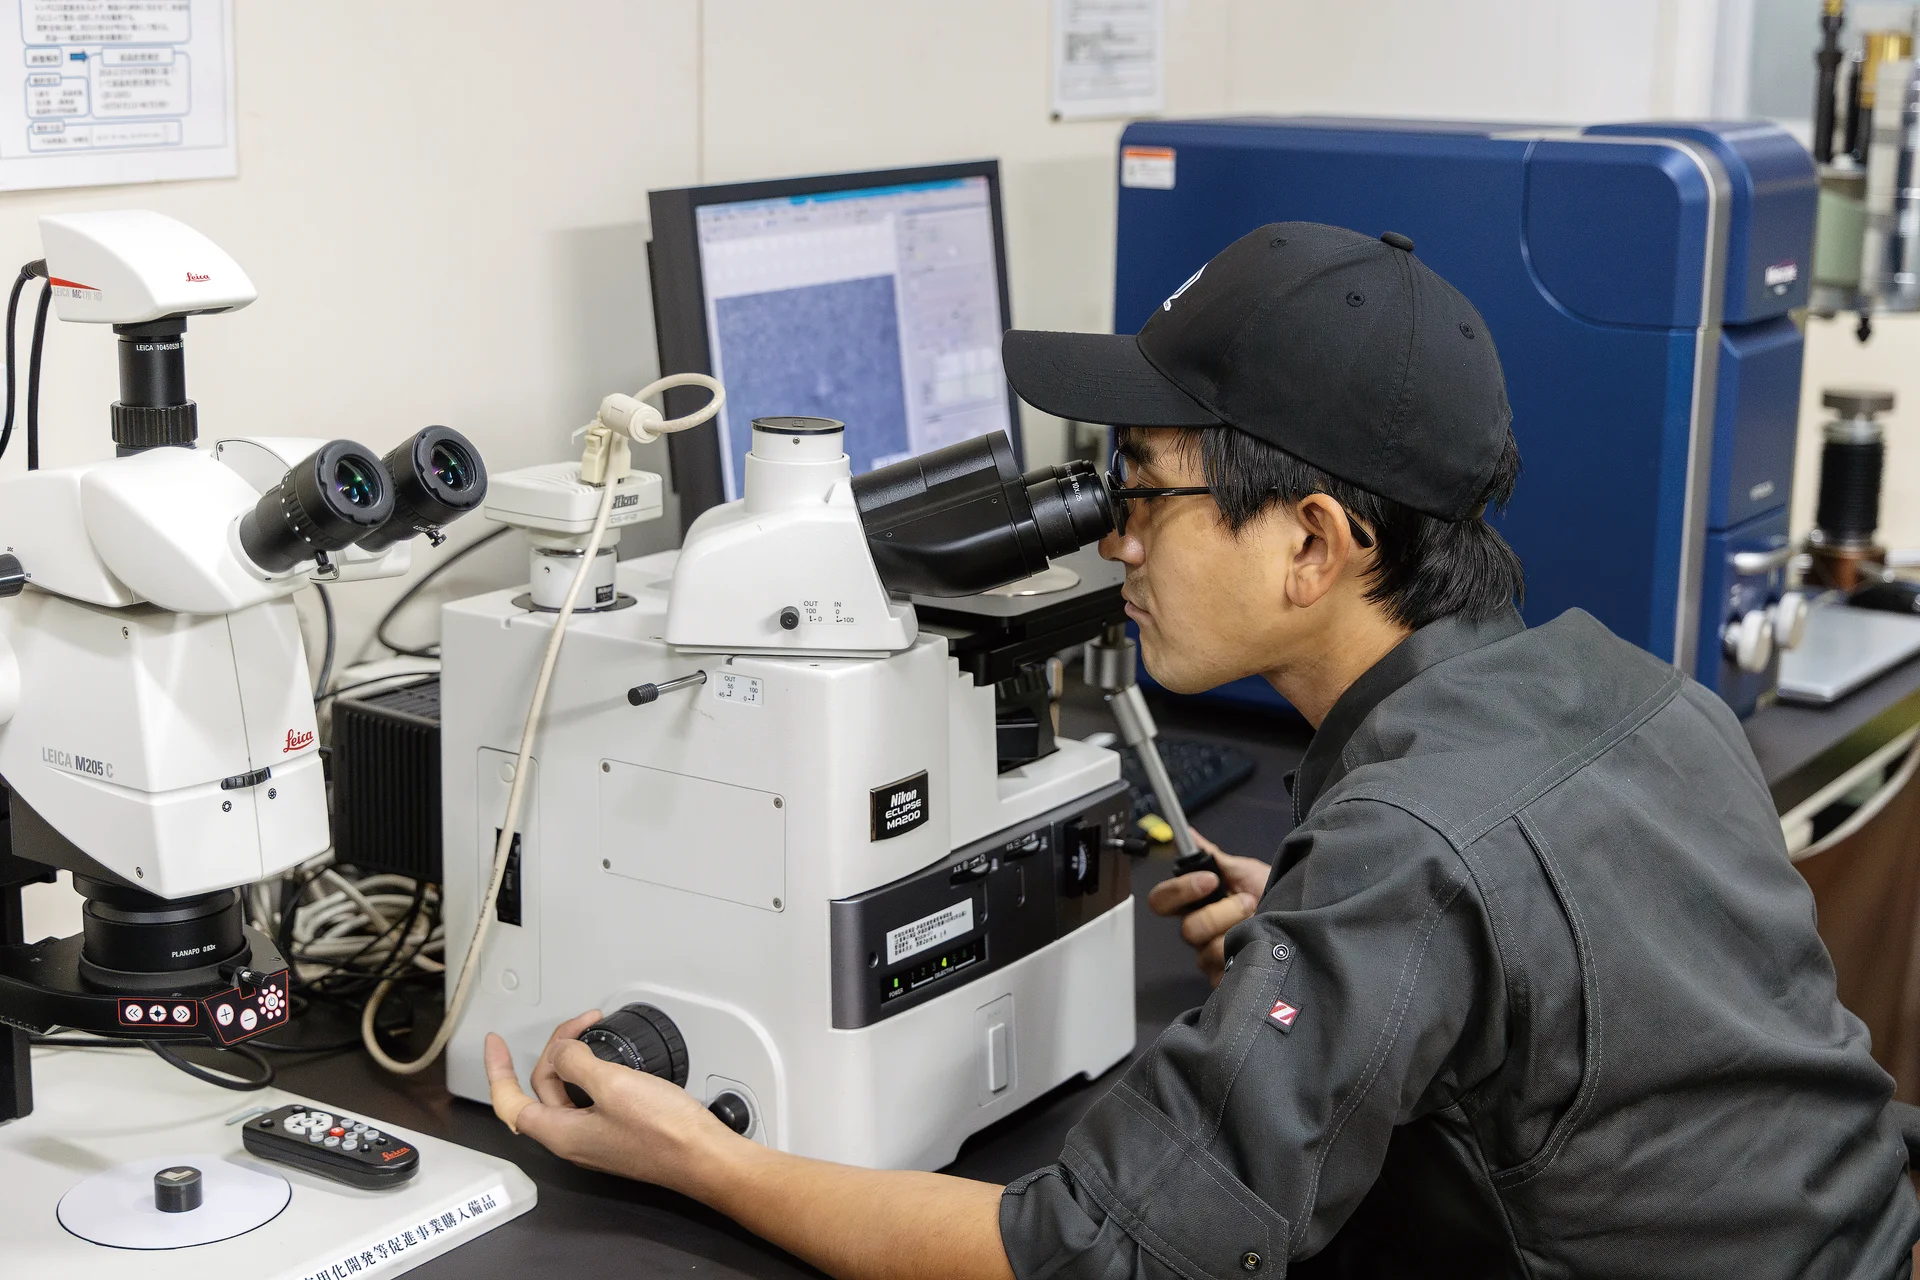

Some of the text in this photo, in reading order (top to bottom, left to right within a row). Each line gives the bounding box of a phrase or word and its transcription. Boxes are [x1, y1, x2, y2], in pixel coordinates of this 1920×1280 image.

[185, 272, 211, 282] Leica
[283, 729, 314, 753] Leica
[42, 746, 114, 778] LEICA M205 C
[890, 789, 917, 808] Nikon
[885, 799, 922, 819] ECLIPSE
[887, 810, 921, 830] MA200
[171, 947, 200, 958] PLANAPO
[941, 957, 948, 967] 4
[889, 988, 904, 998] POWER
[382, 1147, 411, 1162] Leica
[303, 1194, 497, 1280] 用化開発等促進事業購入備品
